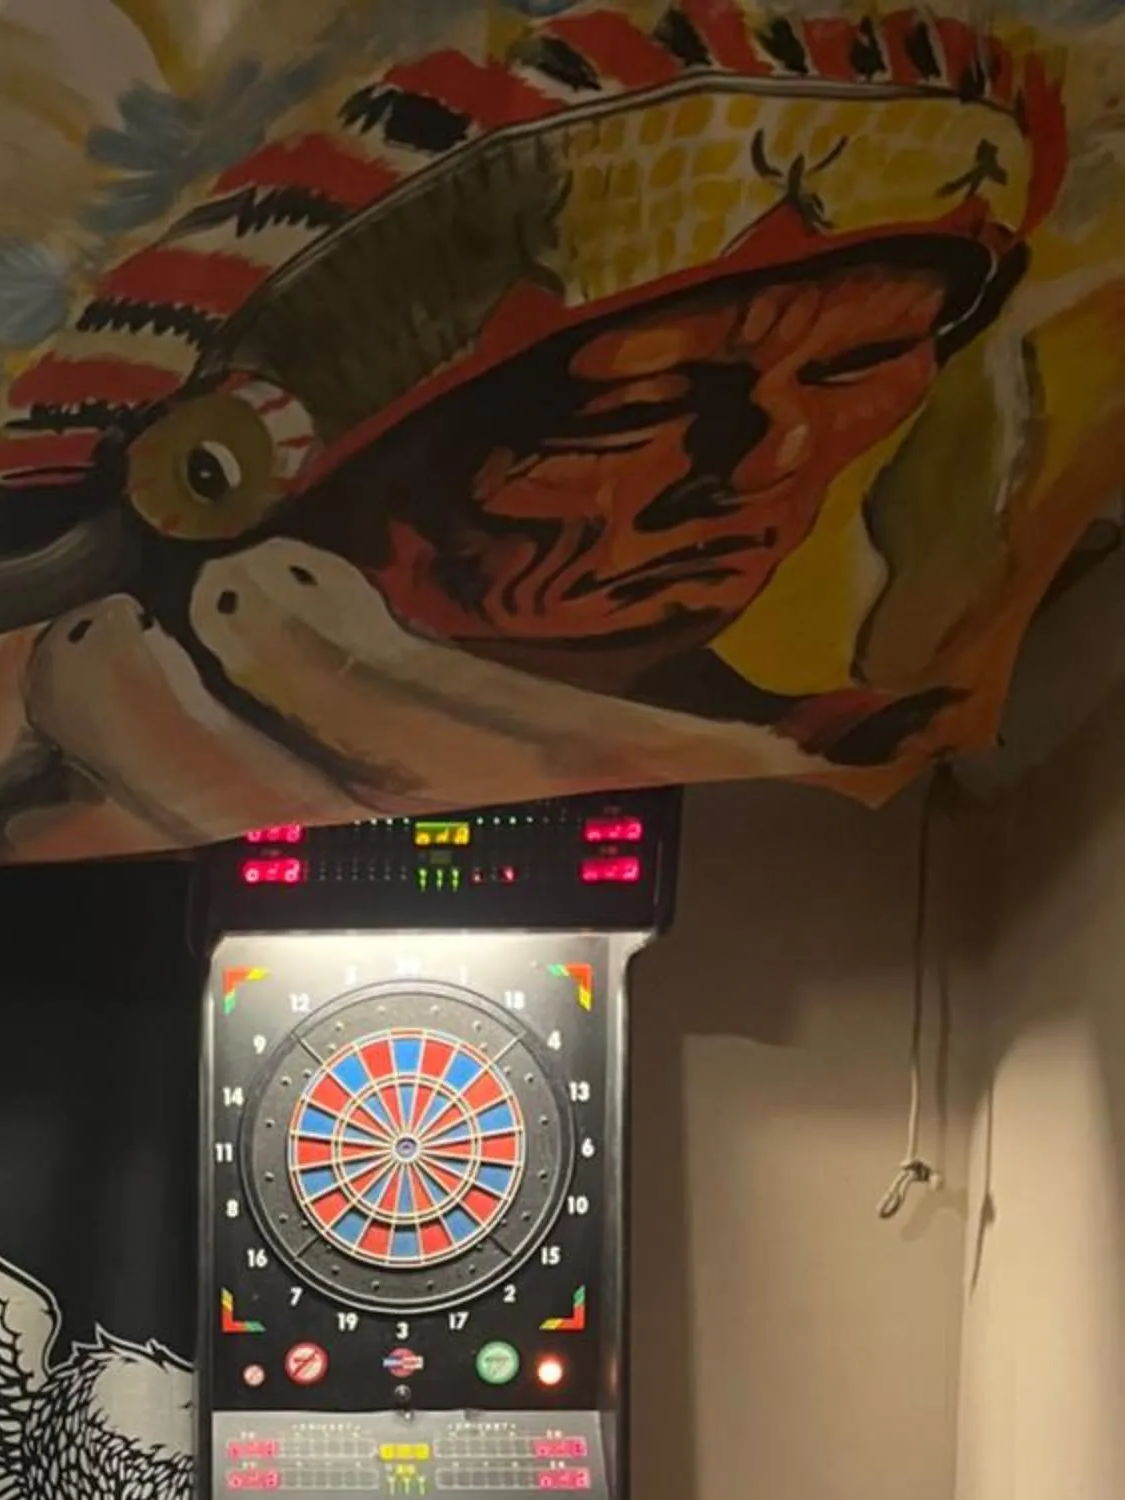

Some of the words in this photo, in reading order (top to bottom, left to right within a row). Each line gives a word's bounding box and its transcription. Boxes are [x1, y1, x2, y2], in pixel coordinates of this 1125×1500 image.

[253, 1034, 267, 1054] 9
[547, 1030, 561, 1050] 4
[223, 1087, 244, 1106] 14
[569, 1081, 590, 1101] 13
[215, 1143, 233, 1162] 11
[581, 1138, 594, 1157] 6
[226, 1199, 239, 1218] 8
[567, 1196, 589, 1214] 10
[247, 1249, 268, 1267] 16
[541, 1246, 560, 1265] 15
[290, 1287, 302, 1305] 7
[503, 1284, 516, 1303] 2
[337, 1312, 358, 1330] 19
[449, 1311, 469, 1329] 17
[396, 1322, 408, 1339] 3
